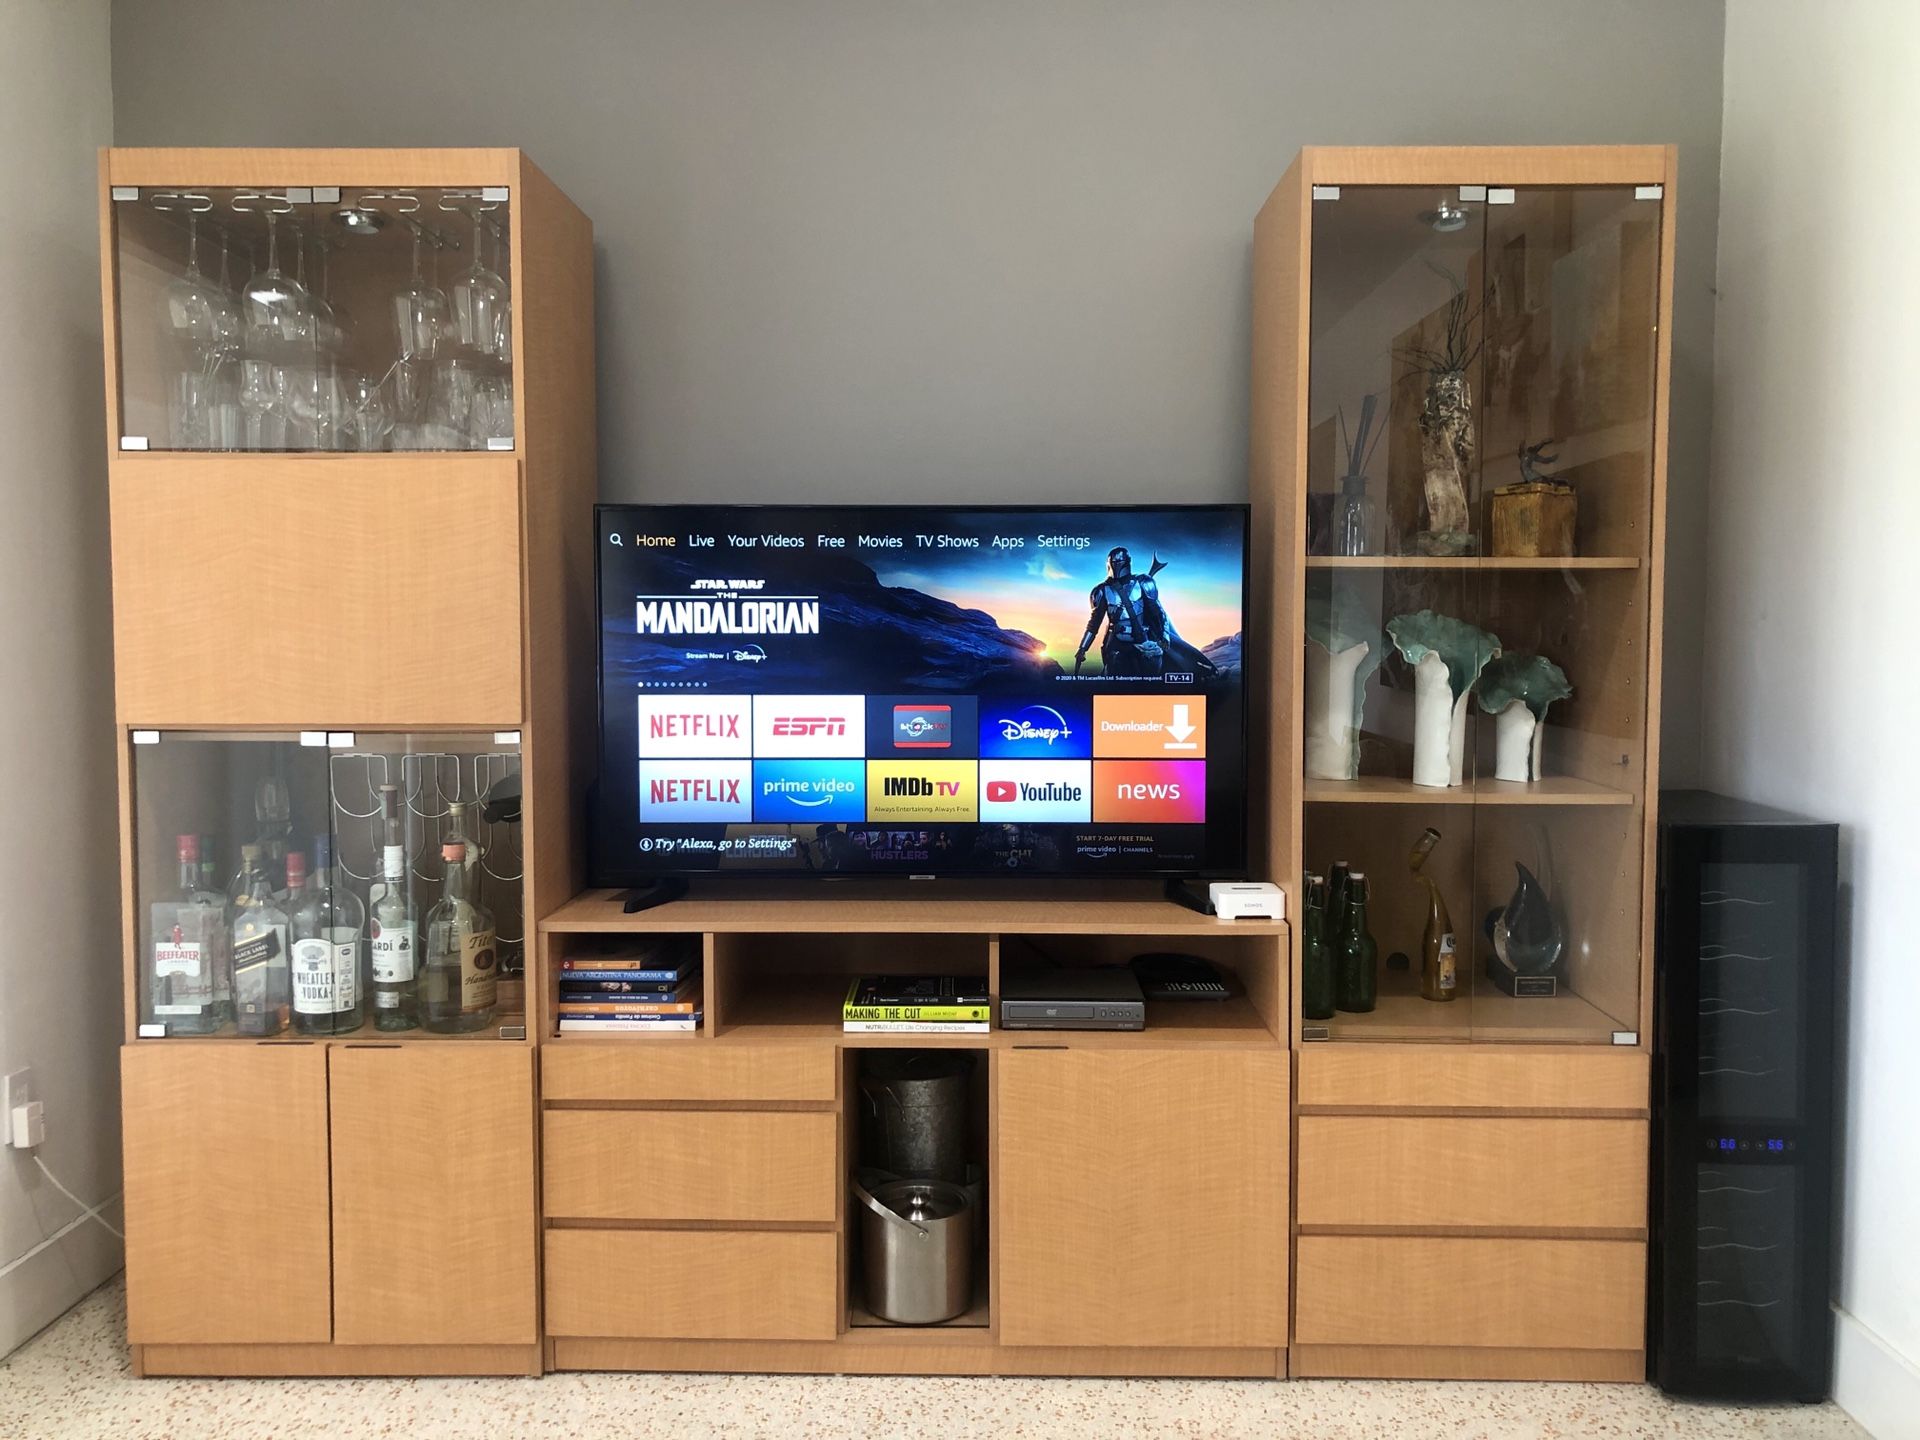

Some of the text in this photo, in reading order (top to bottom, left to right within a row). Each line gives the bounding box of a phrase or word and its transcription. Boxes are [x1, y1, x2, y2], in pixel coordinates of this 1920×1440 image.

[636, 534, 1090, 550] Home Live Your Videos Free Movies TV Shows Apps Settings
[690, 580, 765, 590] STAR WARS
[636, 602, 819, 634] MANDALORIAN
[650, 714, 739, 738] NETFLIX
[773, 717, 846, 736] ESPN
[998, 714, 1072, 746] Disney+
[1102, 720, 1164, 732] Downloader
[650, 780, 740, 804] NETFLIX
[764, 778, 855, 796] prime video
[884, 778, 960, 796] IMDb TV
[1020, 782, 1082, 802] YouTube
[1118, 784, 1180, 800] news
[656, 838, 675, 850] Try
[676, 838, 716, 850] "Alexa,
[718, 840, 732, 851] go
[734, 839, 746, 849] to
[749, 838, 797, 851] Settings"
[871, 850, 929, 860] HUSTLERS
[157, 950, 200, 961] BEEFEATER
[234, 950, 252, 959] BLACK
[302, 987, 330, 999] VODKA
[845, 1008, 921, 1019] MAKING THE CUT
[914, 1024, 943, 1032] Changing
